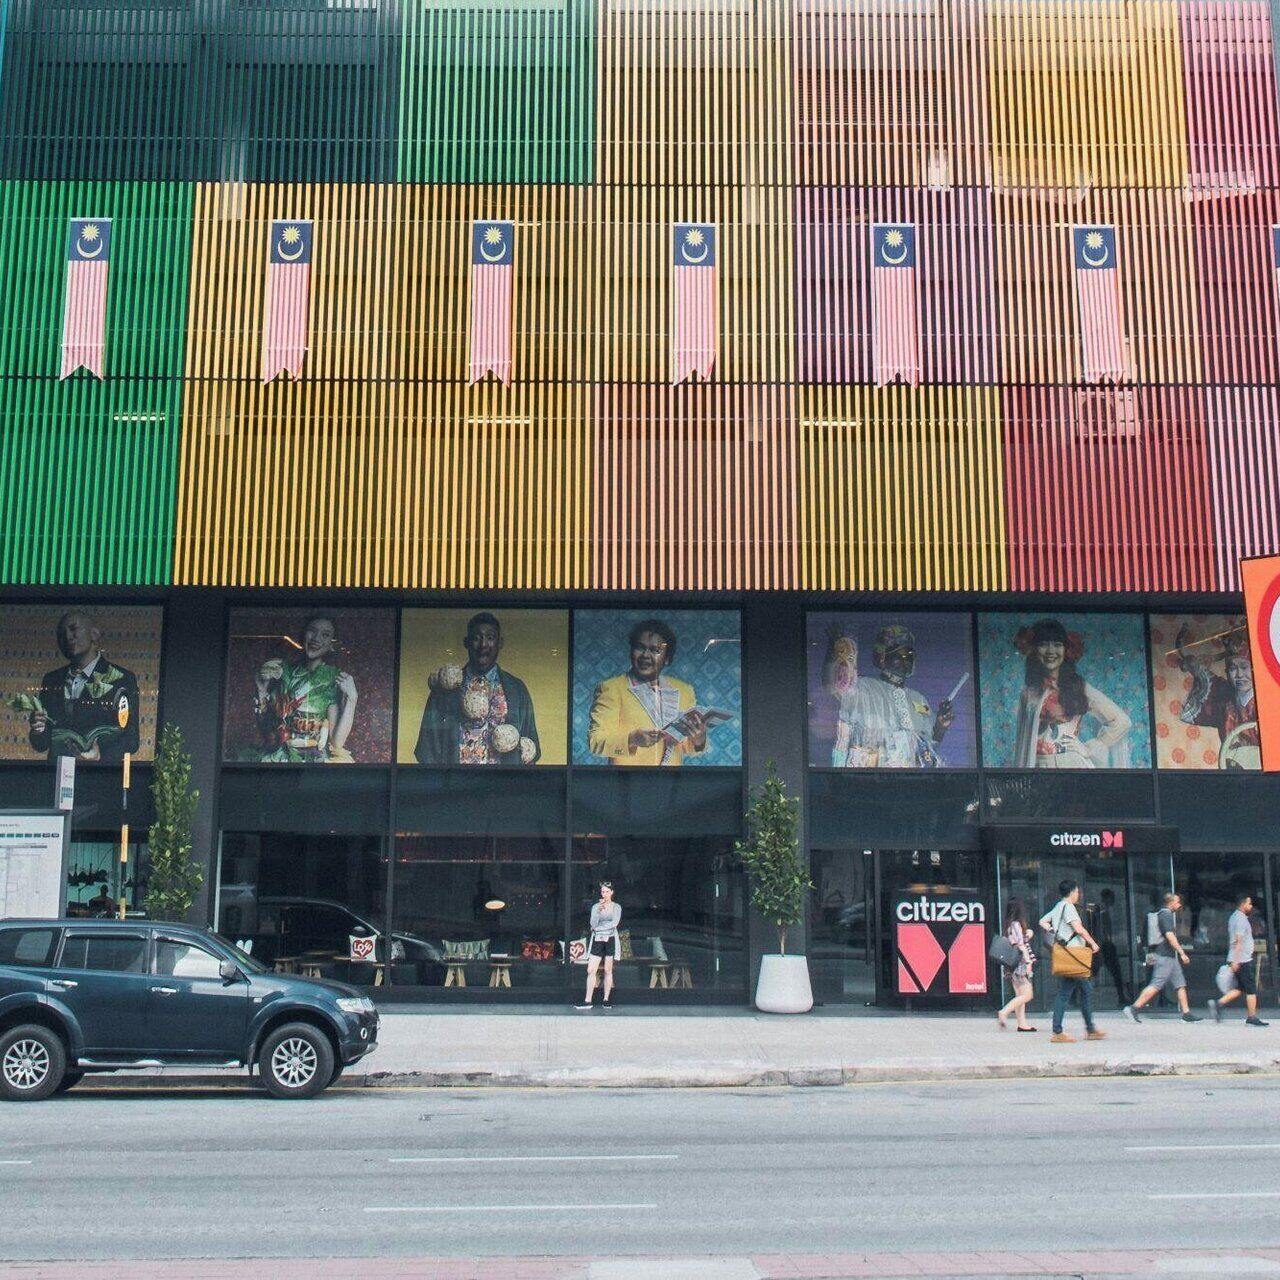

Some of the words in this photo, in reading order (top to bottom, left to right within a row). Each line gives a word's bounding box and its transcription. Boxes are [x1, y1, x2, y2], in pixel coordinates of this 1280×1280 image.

[896, 895, 985, 922] citizen
[896, 923, 988, 993] M
[965, 981, 985, 990] hotel
